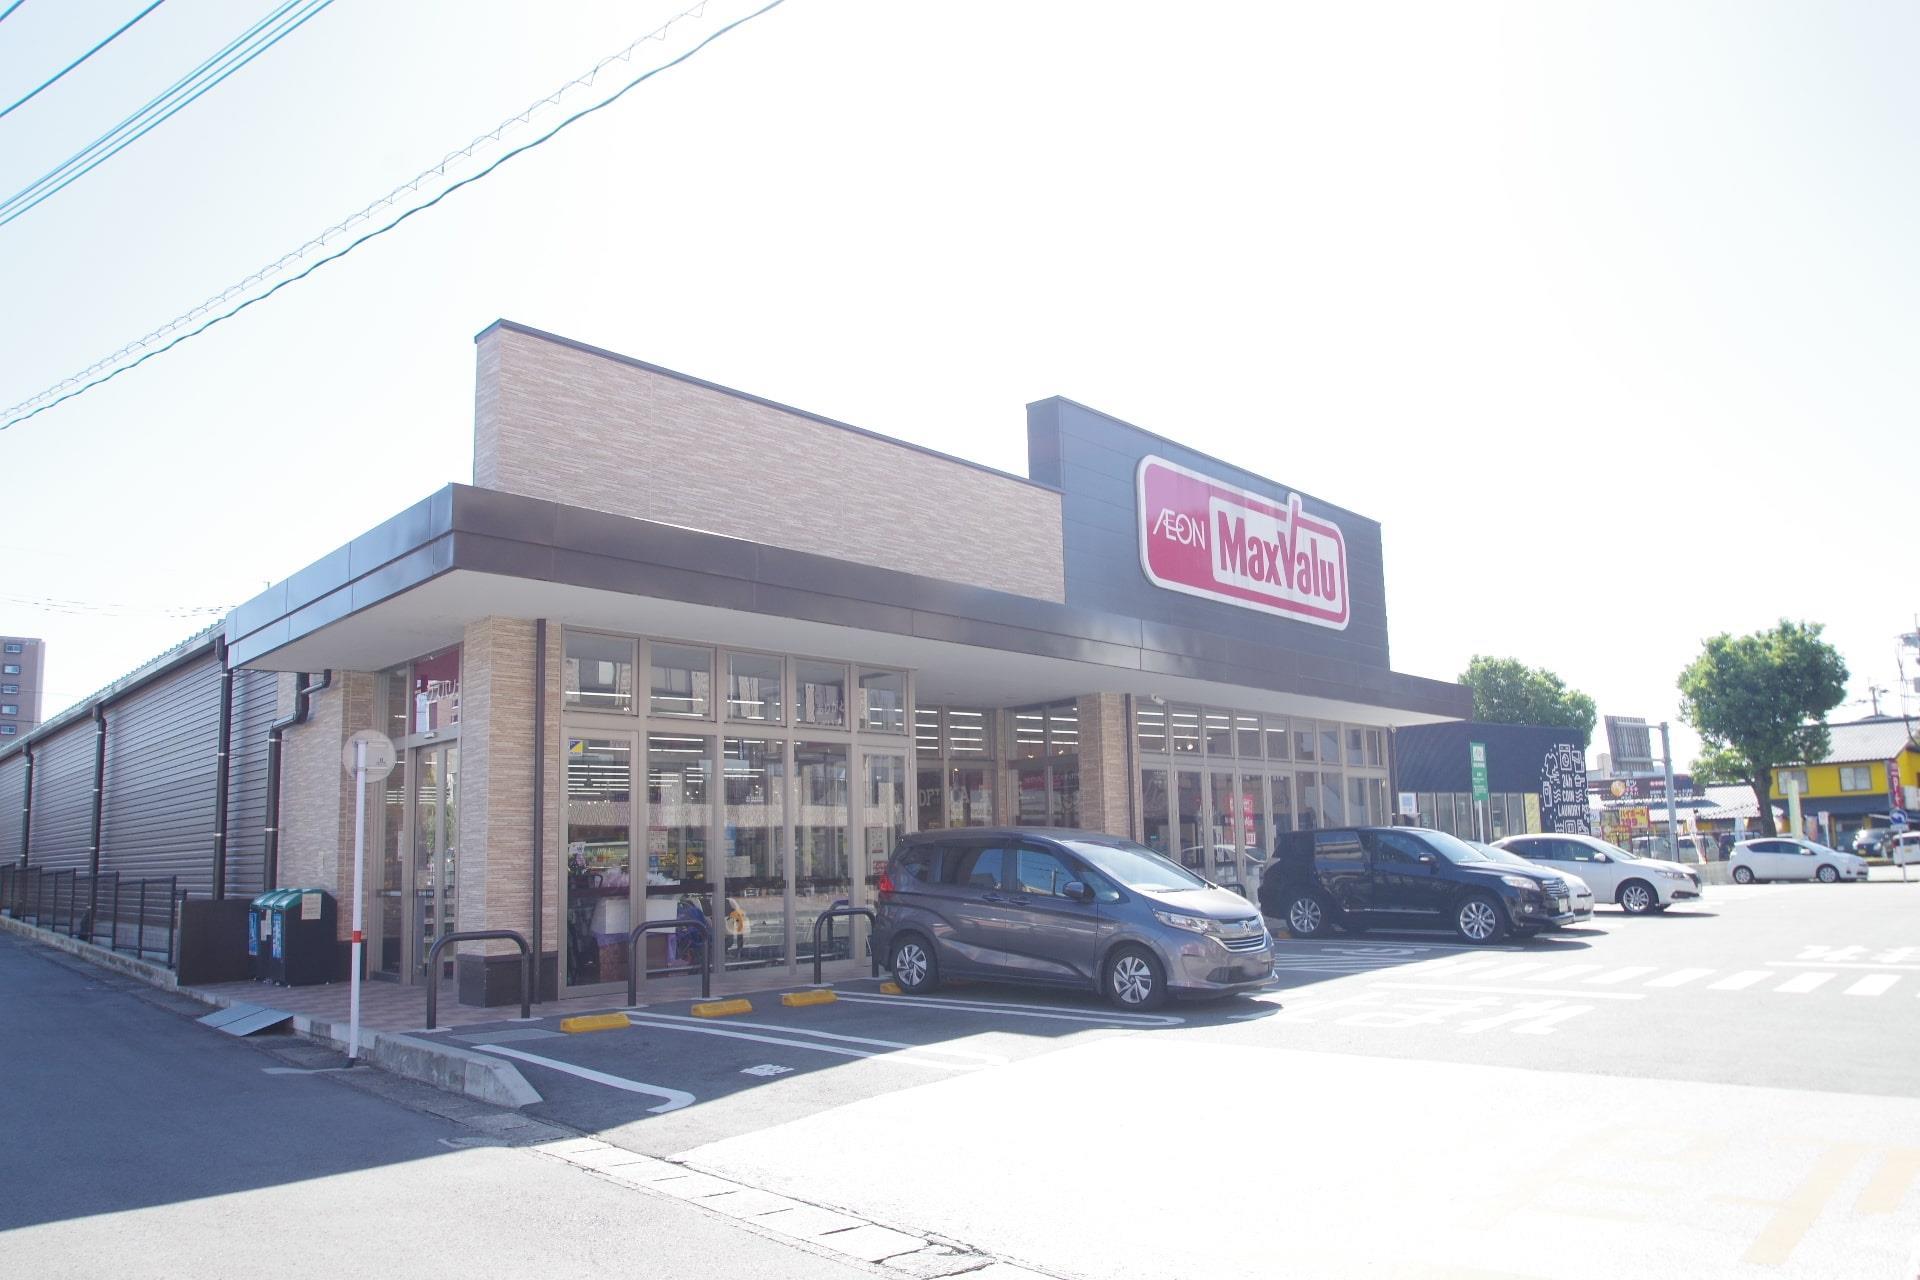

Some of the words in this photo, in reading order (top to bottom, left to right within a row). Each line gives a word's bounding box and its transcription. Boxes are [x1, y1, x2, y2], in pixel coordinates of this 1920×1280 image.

[1218, 500, 1337, 602] MaxValu
[1561, 774, 1573, 788] 24h
[1562, 790, 1575, 804] COIN
[1557, 804, 1581, 817] LAUNDRY
